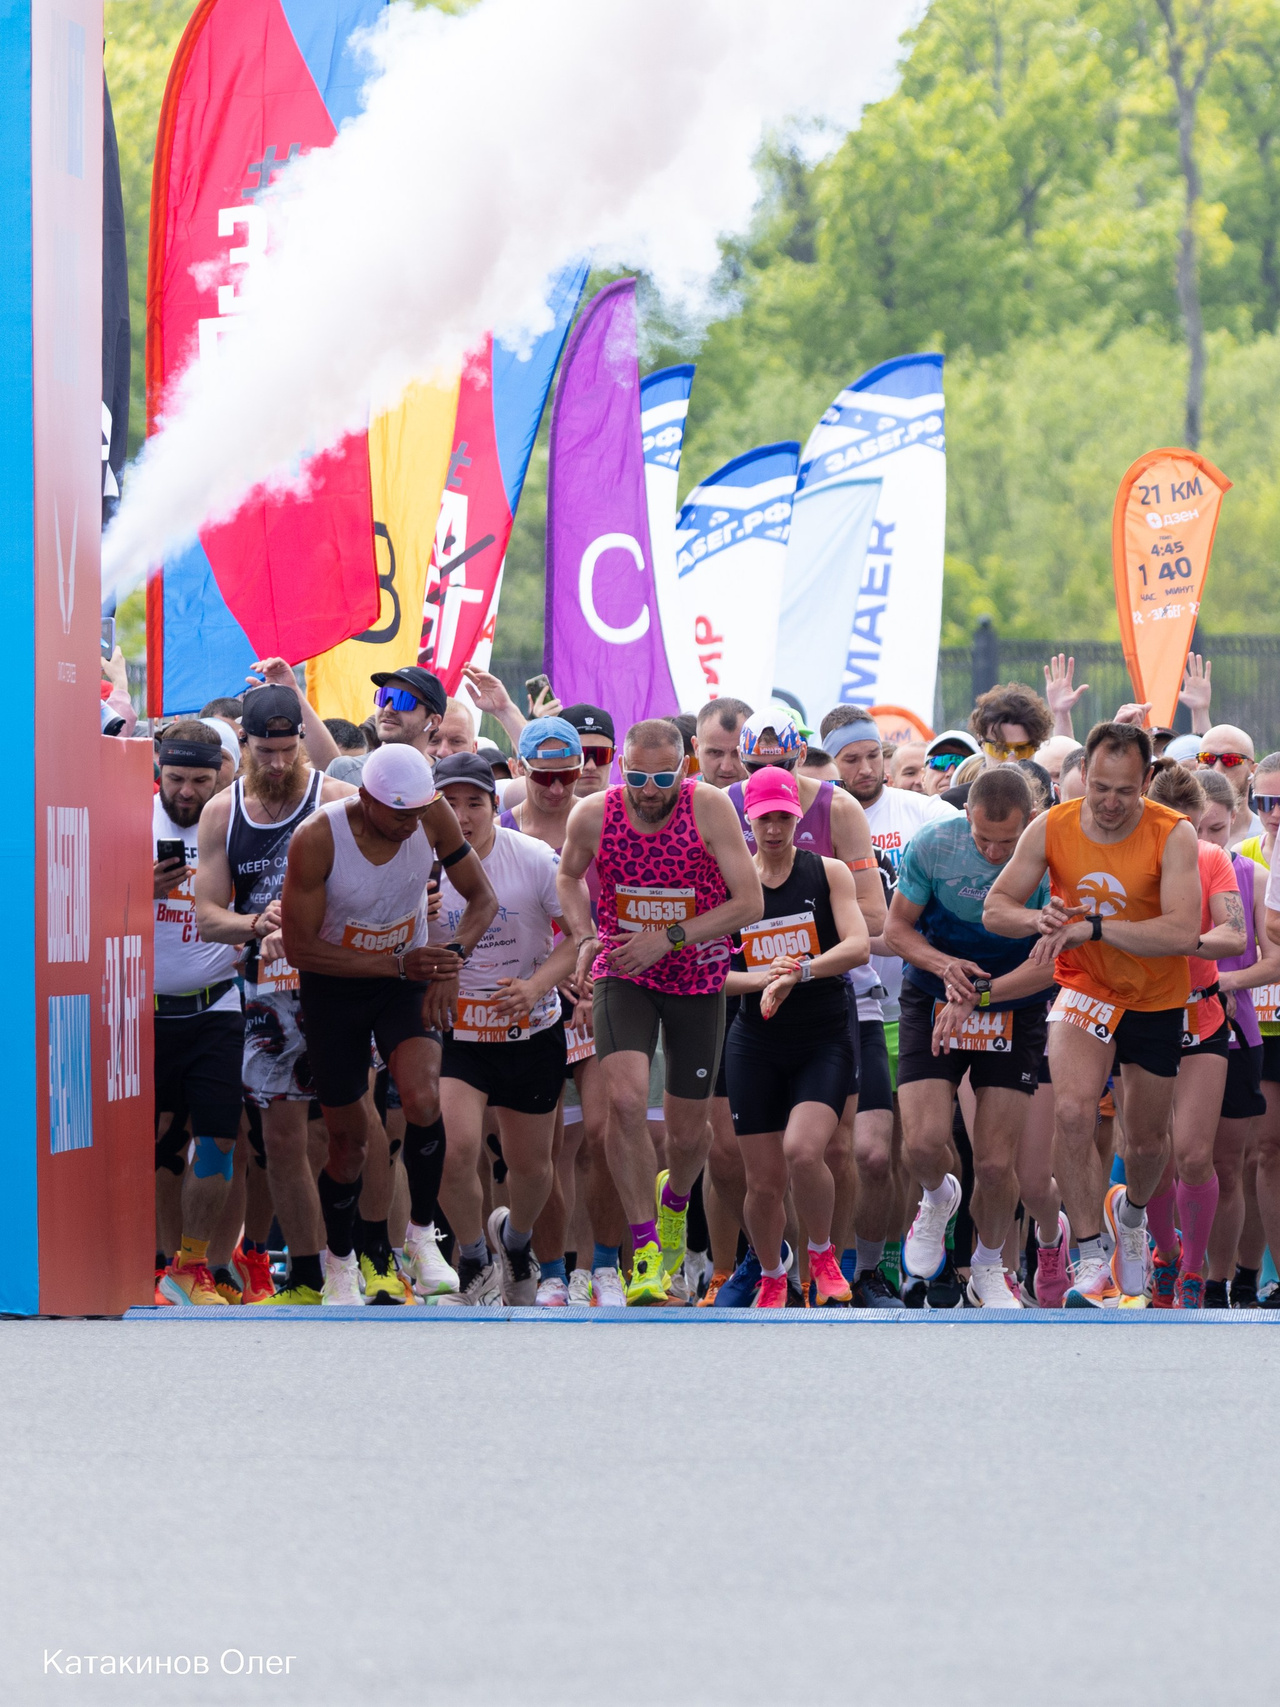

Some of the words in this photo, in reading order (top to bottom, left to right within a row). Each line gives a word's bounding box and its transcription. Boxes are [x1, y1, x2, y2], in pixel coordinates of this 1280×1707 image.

[824, 415, 942, 474] ЗАБЕГ.РФ
[1138, 483, 1160, 506] 21
[677, 501, 793, 569] АБЕГ.РФ
[1151, 541, 1185, 557] 4:45
[1138, 564, 1147, 586] 1
[1158, 556, 1192, 581] 40
[578, 532, 650, 644] C
[1140, 593, 1157, 602] ЧАС
[1165, 585, 1195, 596] МИНУТ
[238, 859, 270, 875] KEEP
[250, 892, 272, 904] KEEP
[626, 900, 687, 921] 40535
[351, 925, 409, 951] 40560
[476, 938, 517, 949] МАРАФОН
[751, 929, 811, 961] 40050
[463, 1004, 518, 1028] 402
